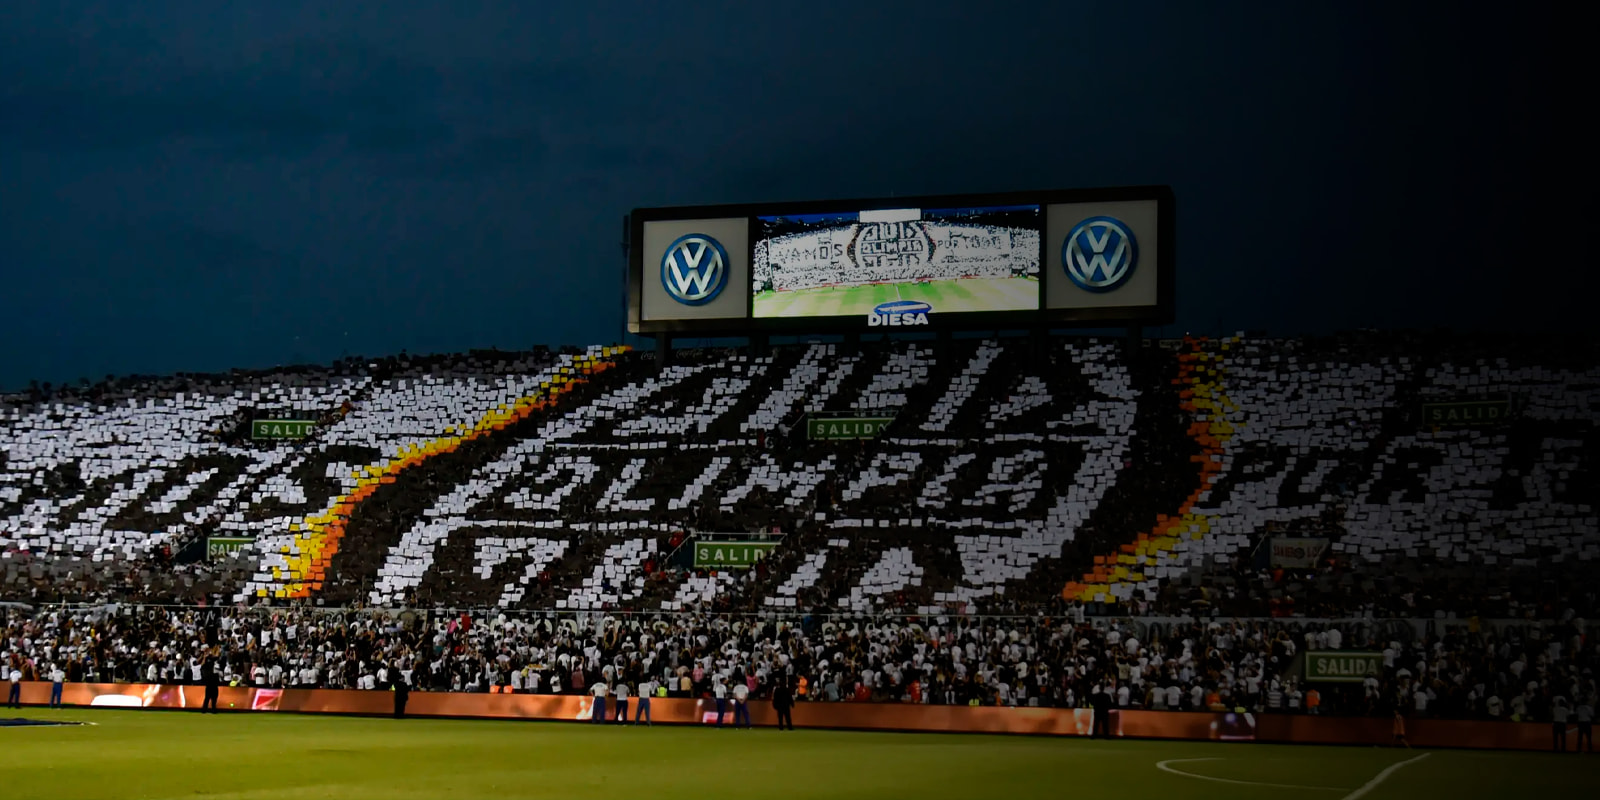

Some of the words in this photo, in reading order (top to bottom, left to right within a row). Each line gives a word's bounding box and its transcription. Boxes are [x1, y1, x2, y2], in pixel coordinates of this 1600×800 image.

[868, 312, 929, 327] DIESA
[260, 424, 313, 436] SALID
[699, 548, 764, 561] SALID
[1316, 657, 1378, 675] SALIDA
